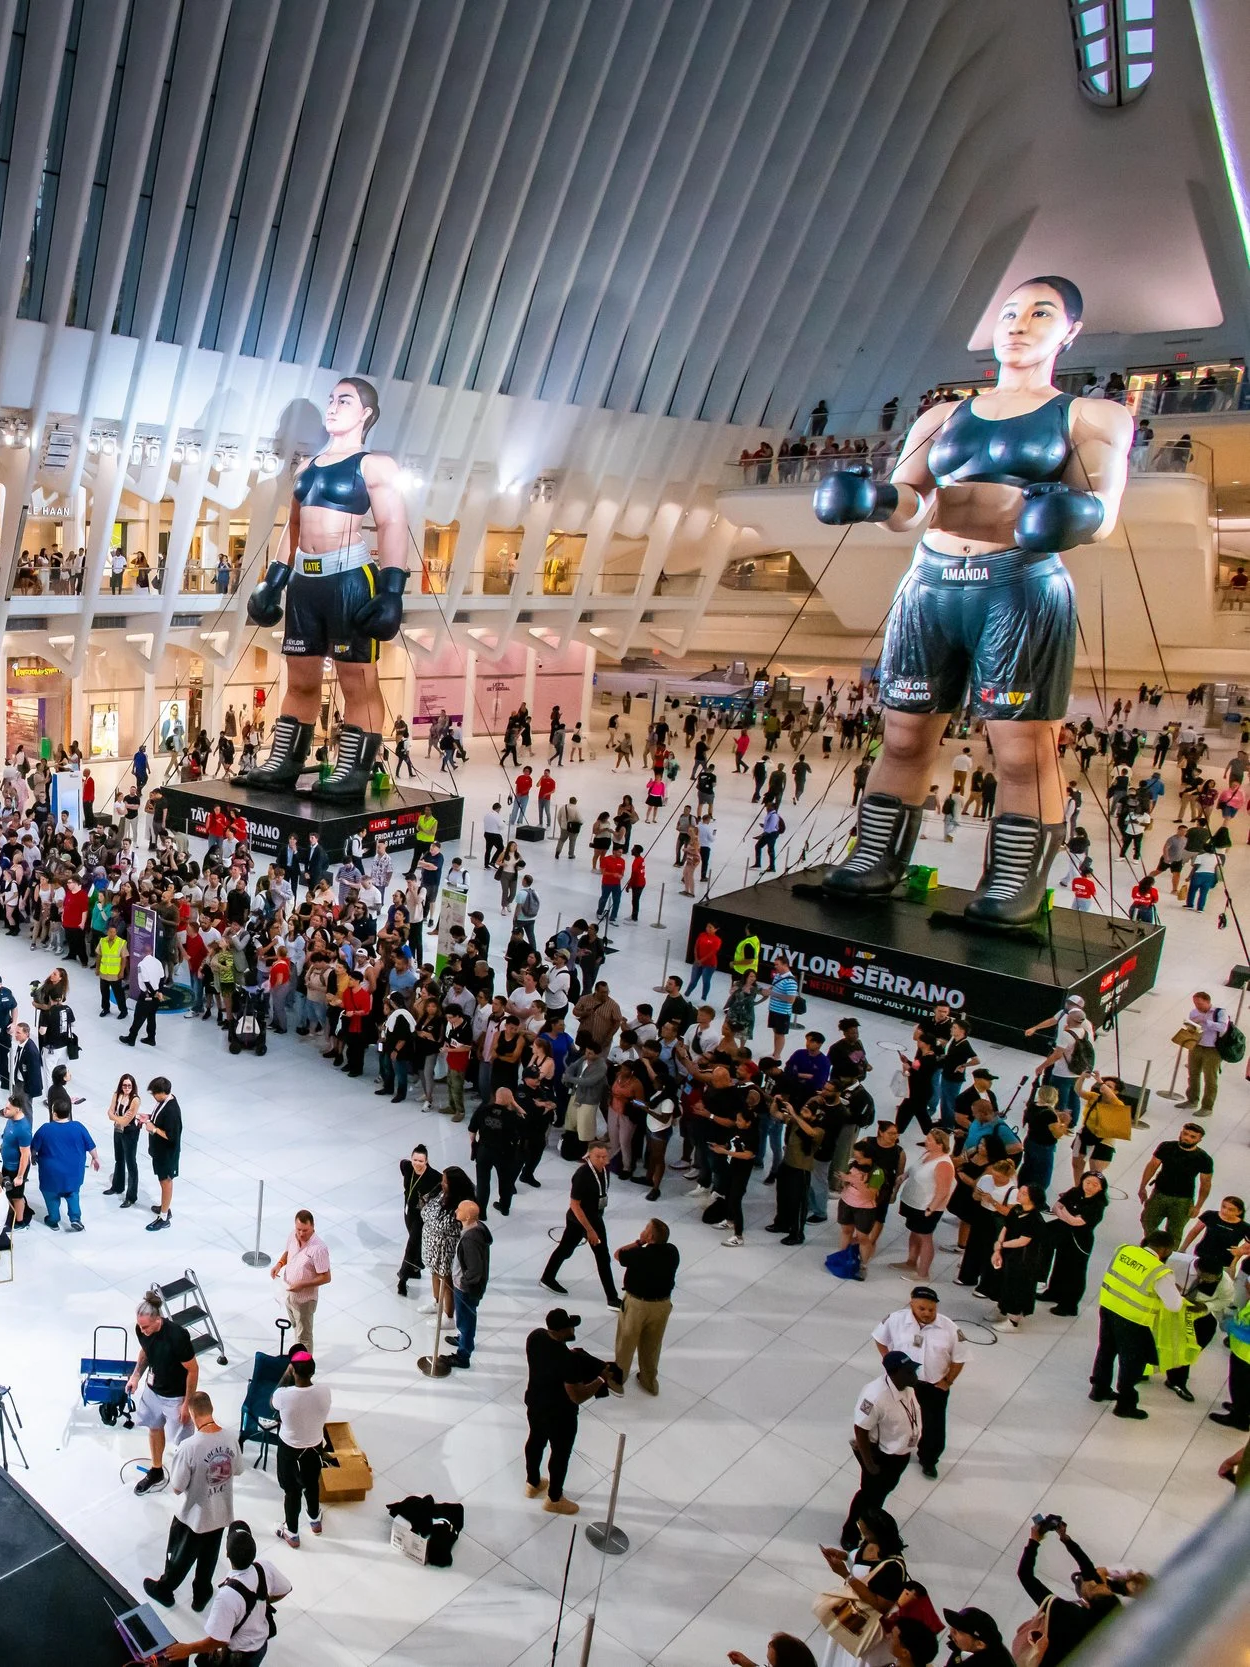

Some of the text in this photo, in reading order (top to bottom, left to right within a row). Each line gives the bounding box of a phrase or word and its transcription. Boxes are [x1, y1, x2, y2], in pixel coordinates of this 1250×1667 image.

[42, 507, 70, 516] HAAN
[303, 561, 321, 572] KATIE
[941, 567, 989, 581] AMANDA
[893, 679, 928, 691] TAYLOR
[887, 688, 932, 701] SERRANO
[244, 820, 280, 841] RRANO
[373, 820, 387, 829] LIVE
[374, 827, 415, 842] FRIDAY JULY 11
[388, 838, 398, 847] PM
[397, 837, 405, 845] ET
[761, 944, 841, 979] TAYLOR
[851, 964, 966, 1010] SERRANO
[809, 978, 845, 997] NETFLIX
[854, 992, 883, 1006] FRIDAY
[883, 999, 906, 1012] JULY
[906, 1006, 916, 1015] 11
[1119, 1253, 1148, 1274] SECURITY
